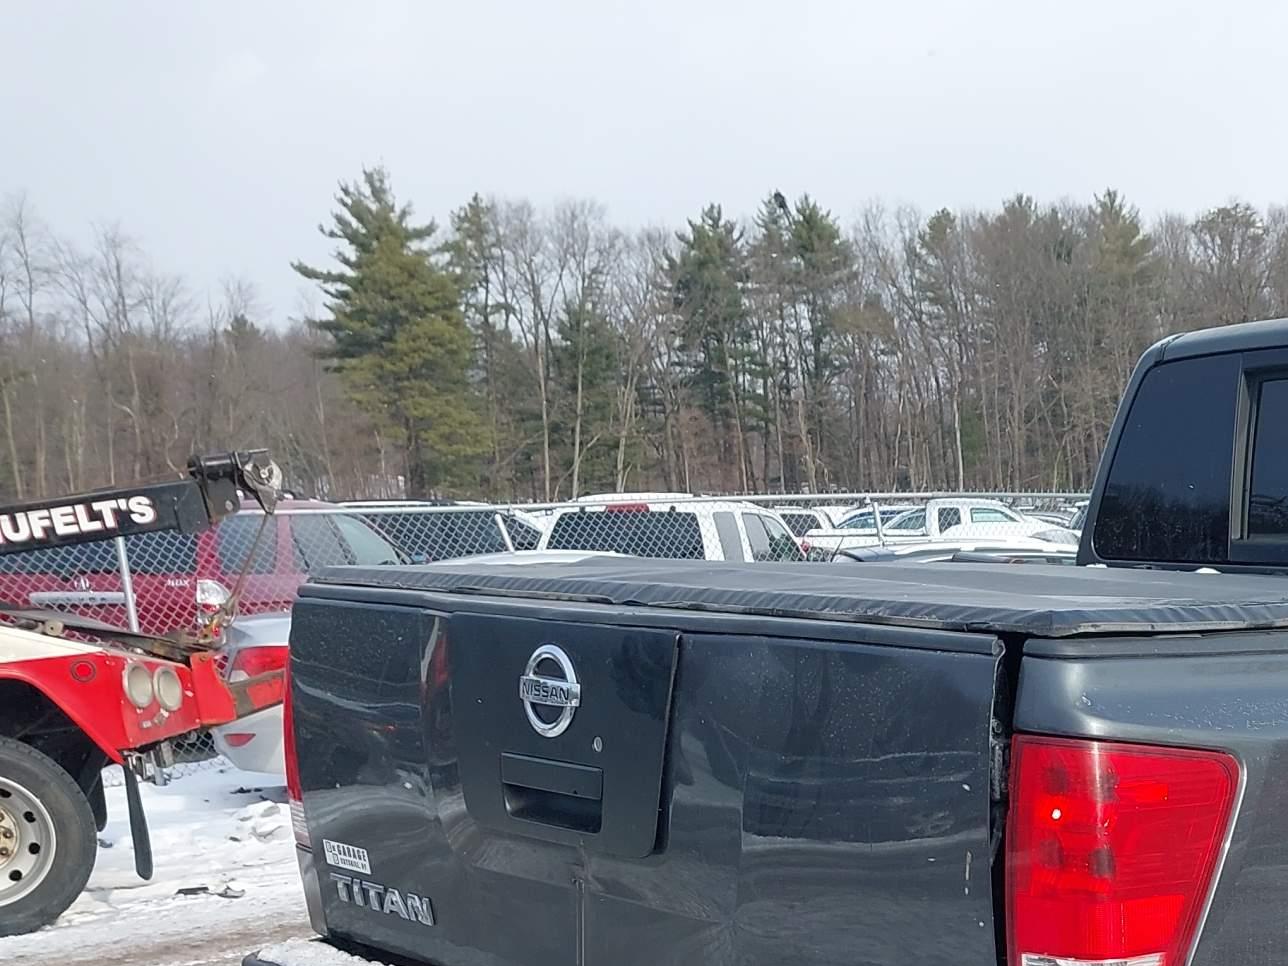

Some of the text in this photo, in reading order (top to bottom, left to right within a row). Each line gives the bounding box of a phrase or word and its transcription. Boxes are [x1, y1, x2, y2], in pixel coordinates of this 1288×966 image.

[0, 495, 156, 544] UFELT'S
[523, 682, 569, 700] NISSAN
[330, 873, 434, 926] TITAN
